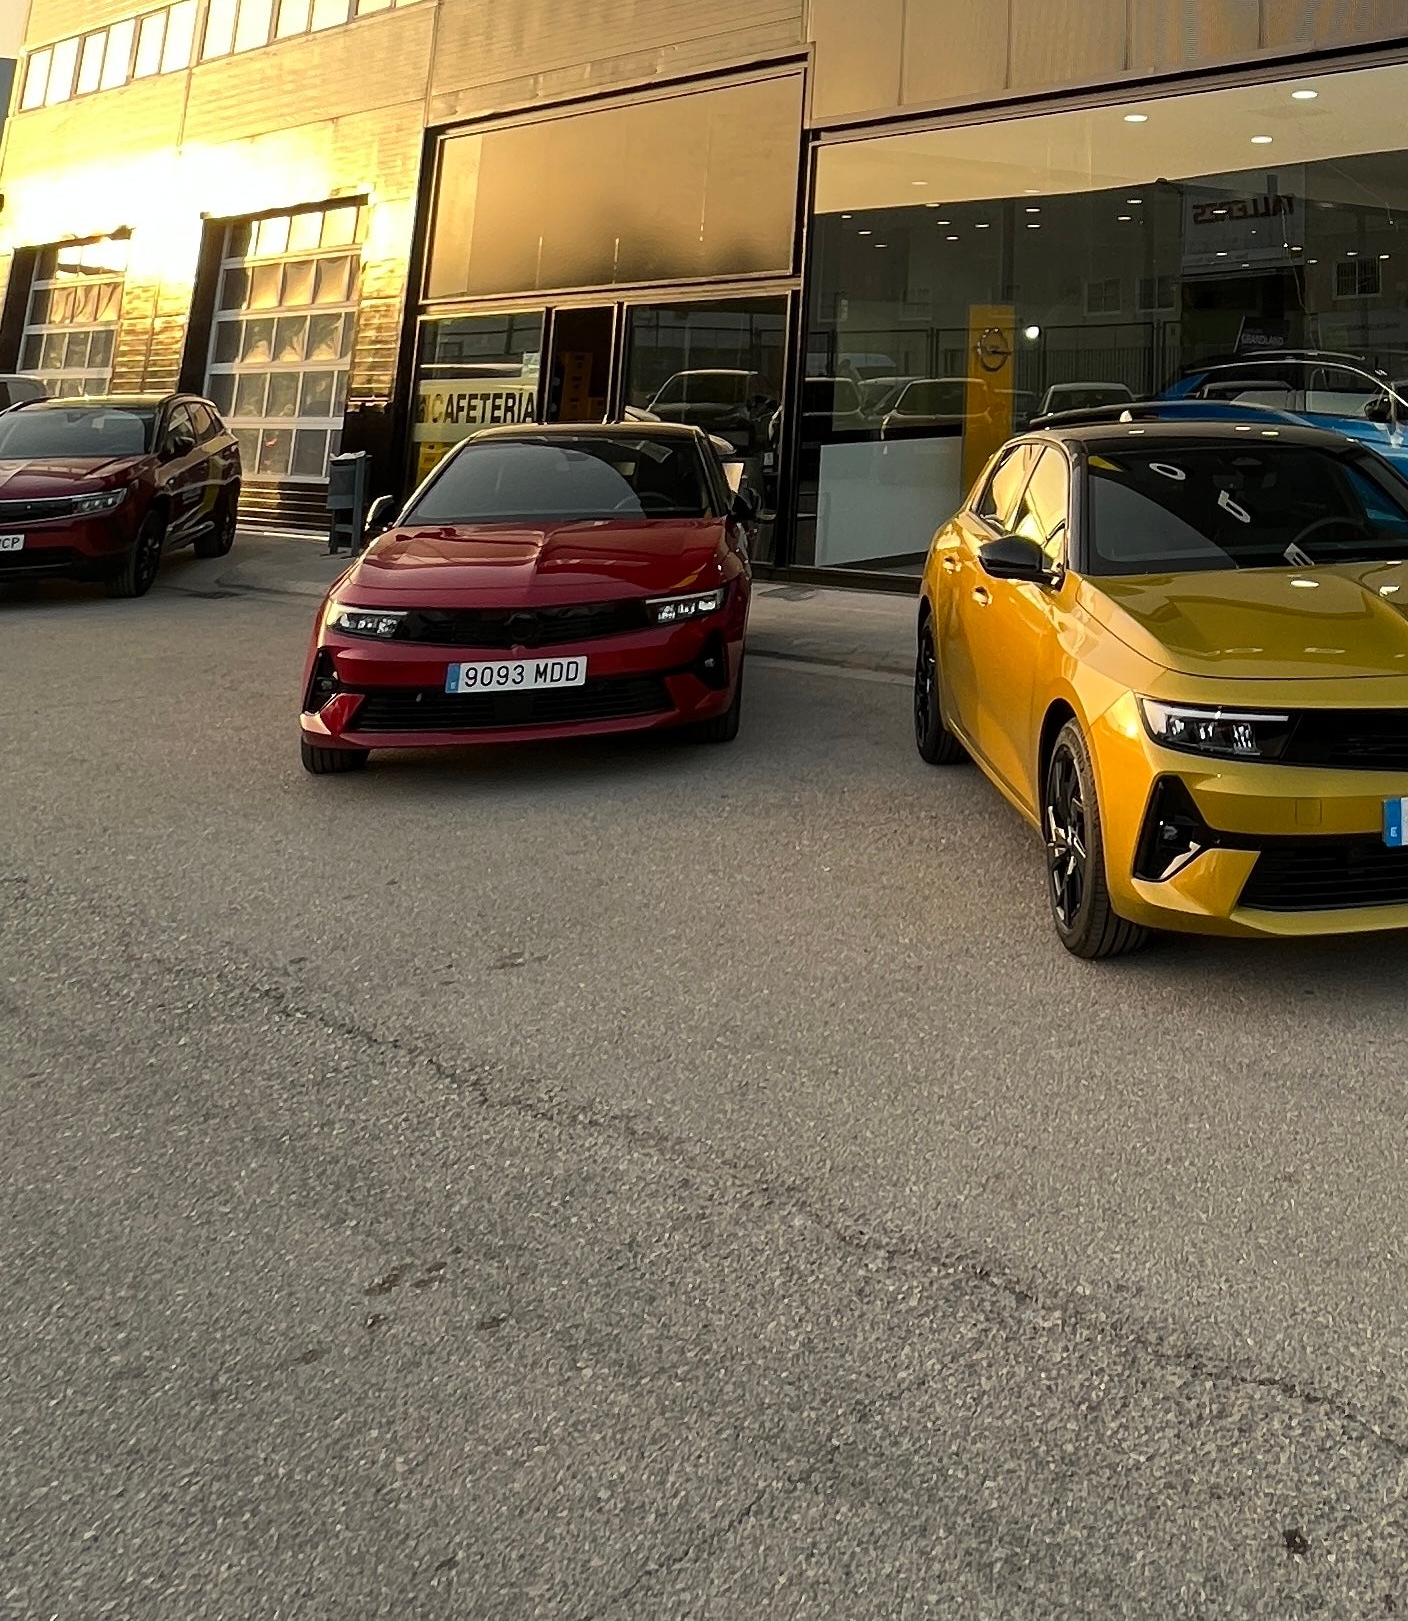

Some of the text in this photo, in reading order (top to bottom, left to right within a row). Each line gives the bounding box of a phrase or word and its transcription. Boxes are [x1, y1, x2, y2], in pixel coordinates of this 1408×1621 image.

[0, 538, 20, 549] CP
[464, 664, 525, 688] 9093
[534, 661, 579, 684] MDD
